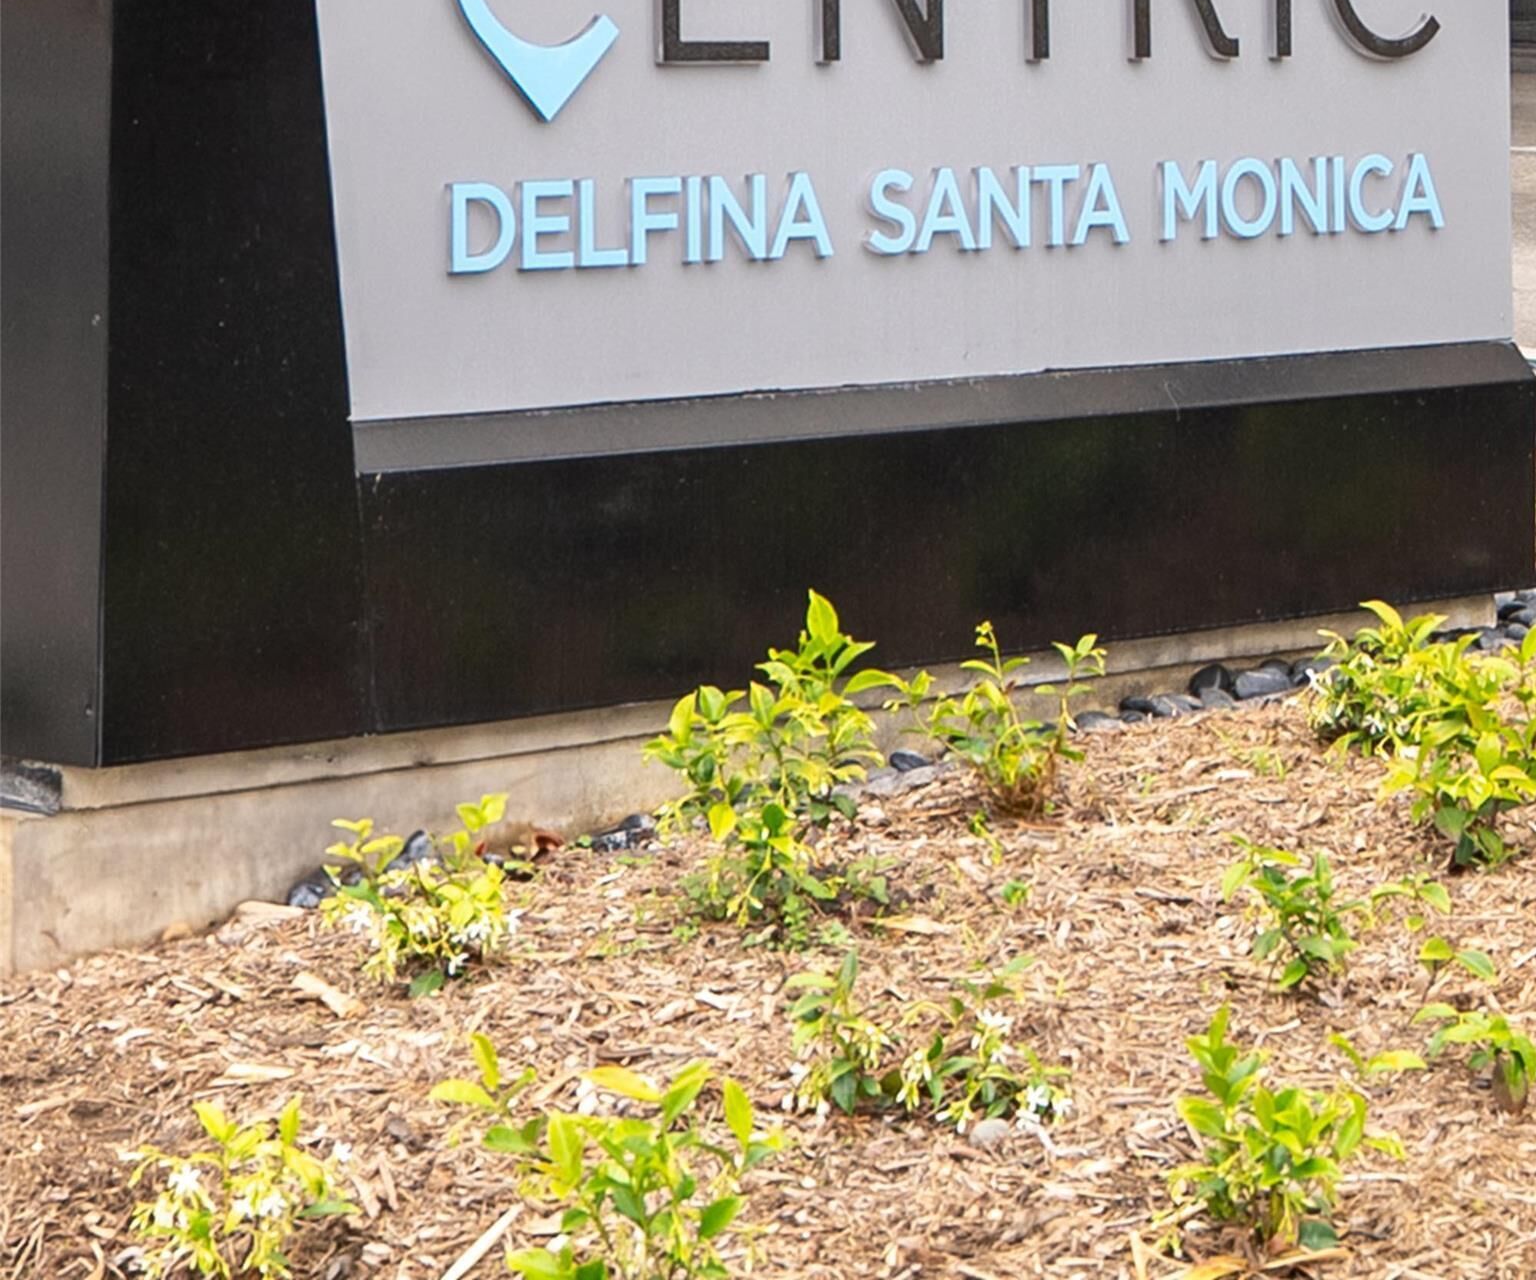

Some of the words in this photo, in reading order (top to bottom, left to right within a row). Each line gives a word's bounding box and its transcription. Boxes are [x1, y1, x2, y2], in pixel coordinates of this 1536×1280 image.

[447, 173, 832, 276] DELFINA
[868, 165, 1129, 256] SANTA
[1162, 154, 1444, 241] MONICA
